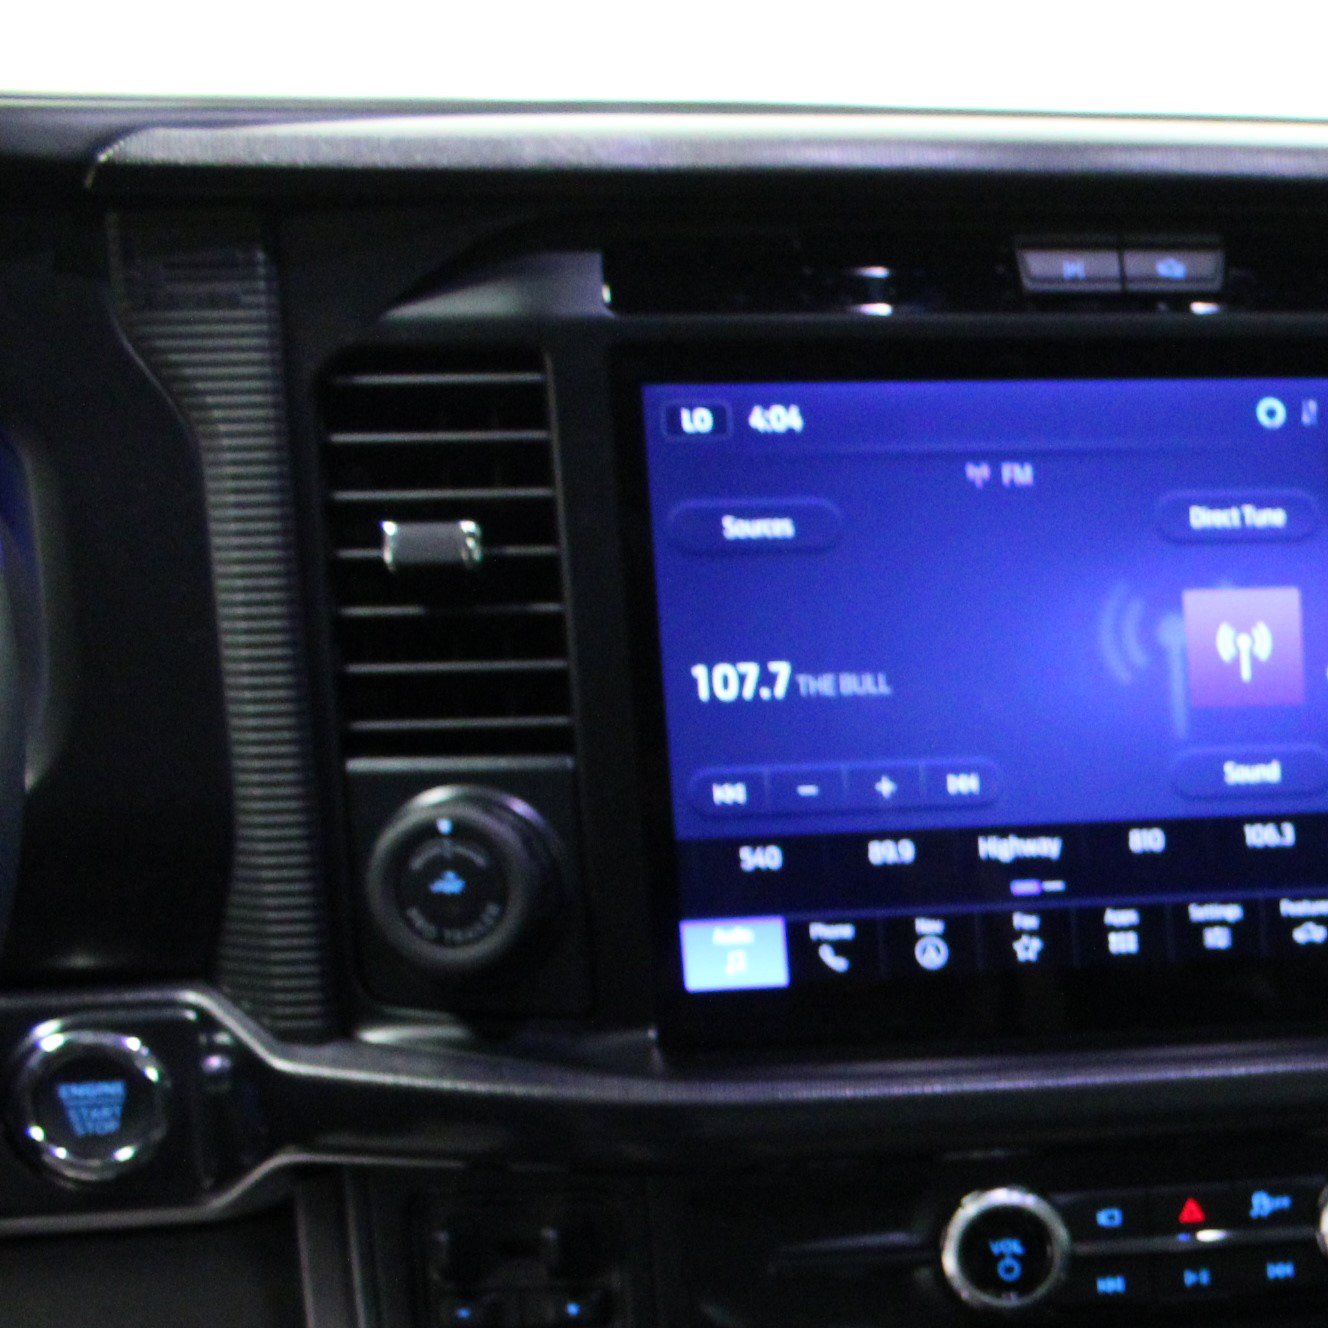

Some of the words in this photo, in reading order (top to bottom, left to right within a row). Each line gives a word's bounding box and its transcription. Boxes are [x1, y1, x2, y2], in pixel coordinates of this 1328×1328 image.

[748, 404, 804, 434] 4:04
[690, 660, 792, 703] 107.7
[796, 674, 836, 698] THE
[838, 672, 892, 696] BULL
[1223, 758, 1282, 786] Sound
[739, 845, 784, 873] 540
[976, 834, 1064, 864] Highway
